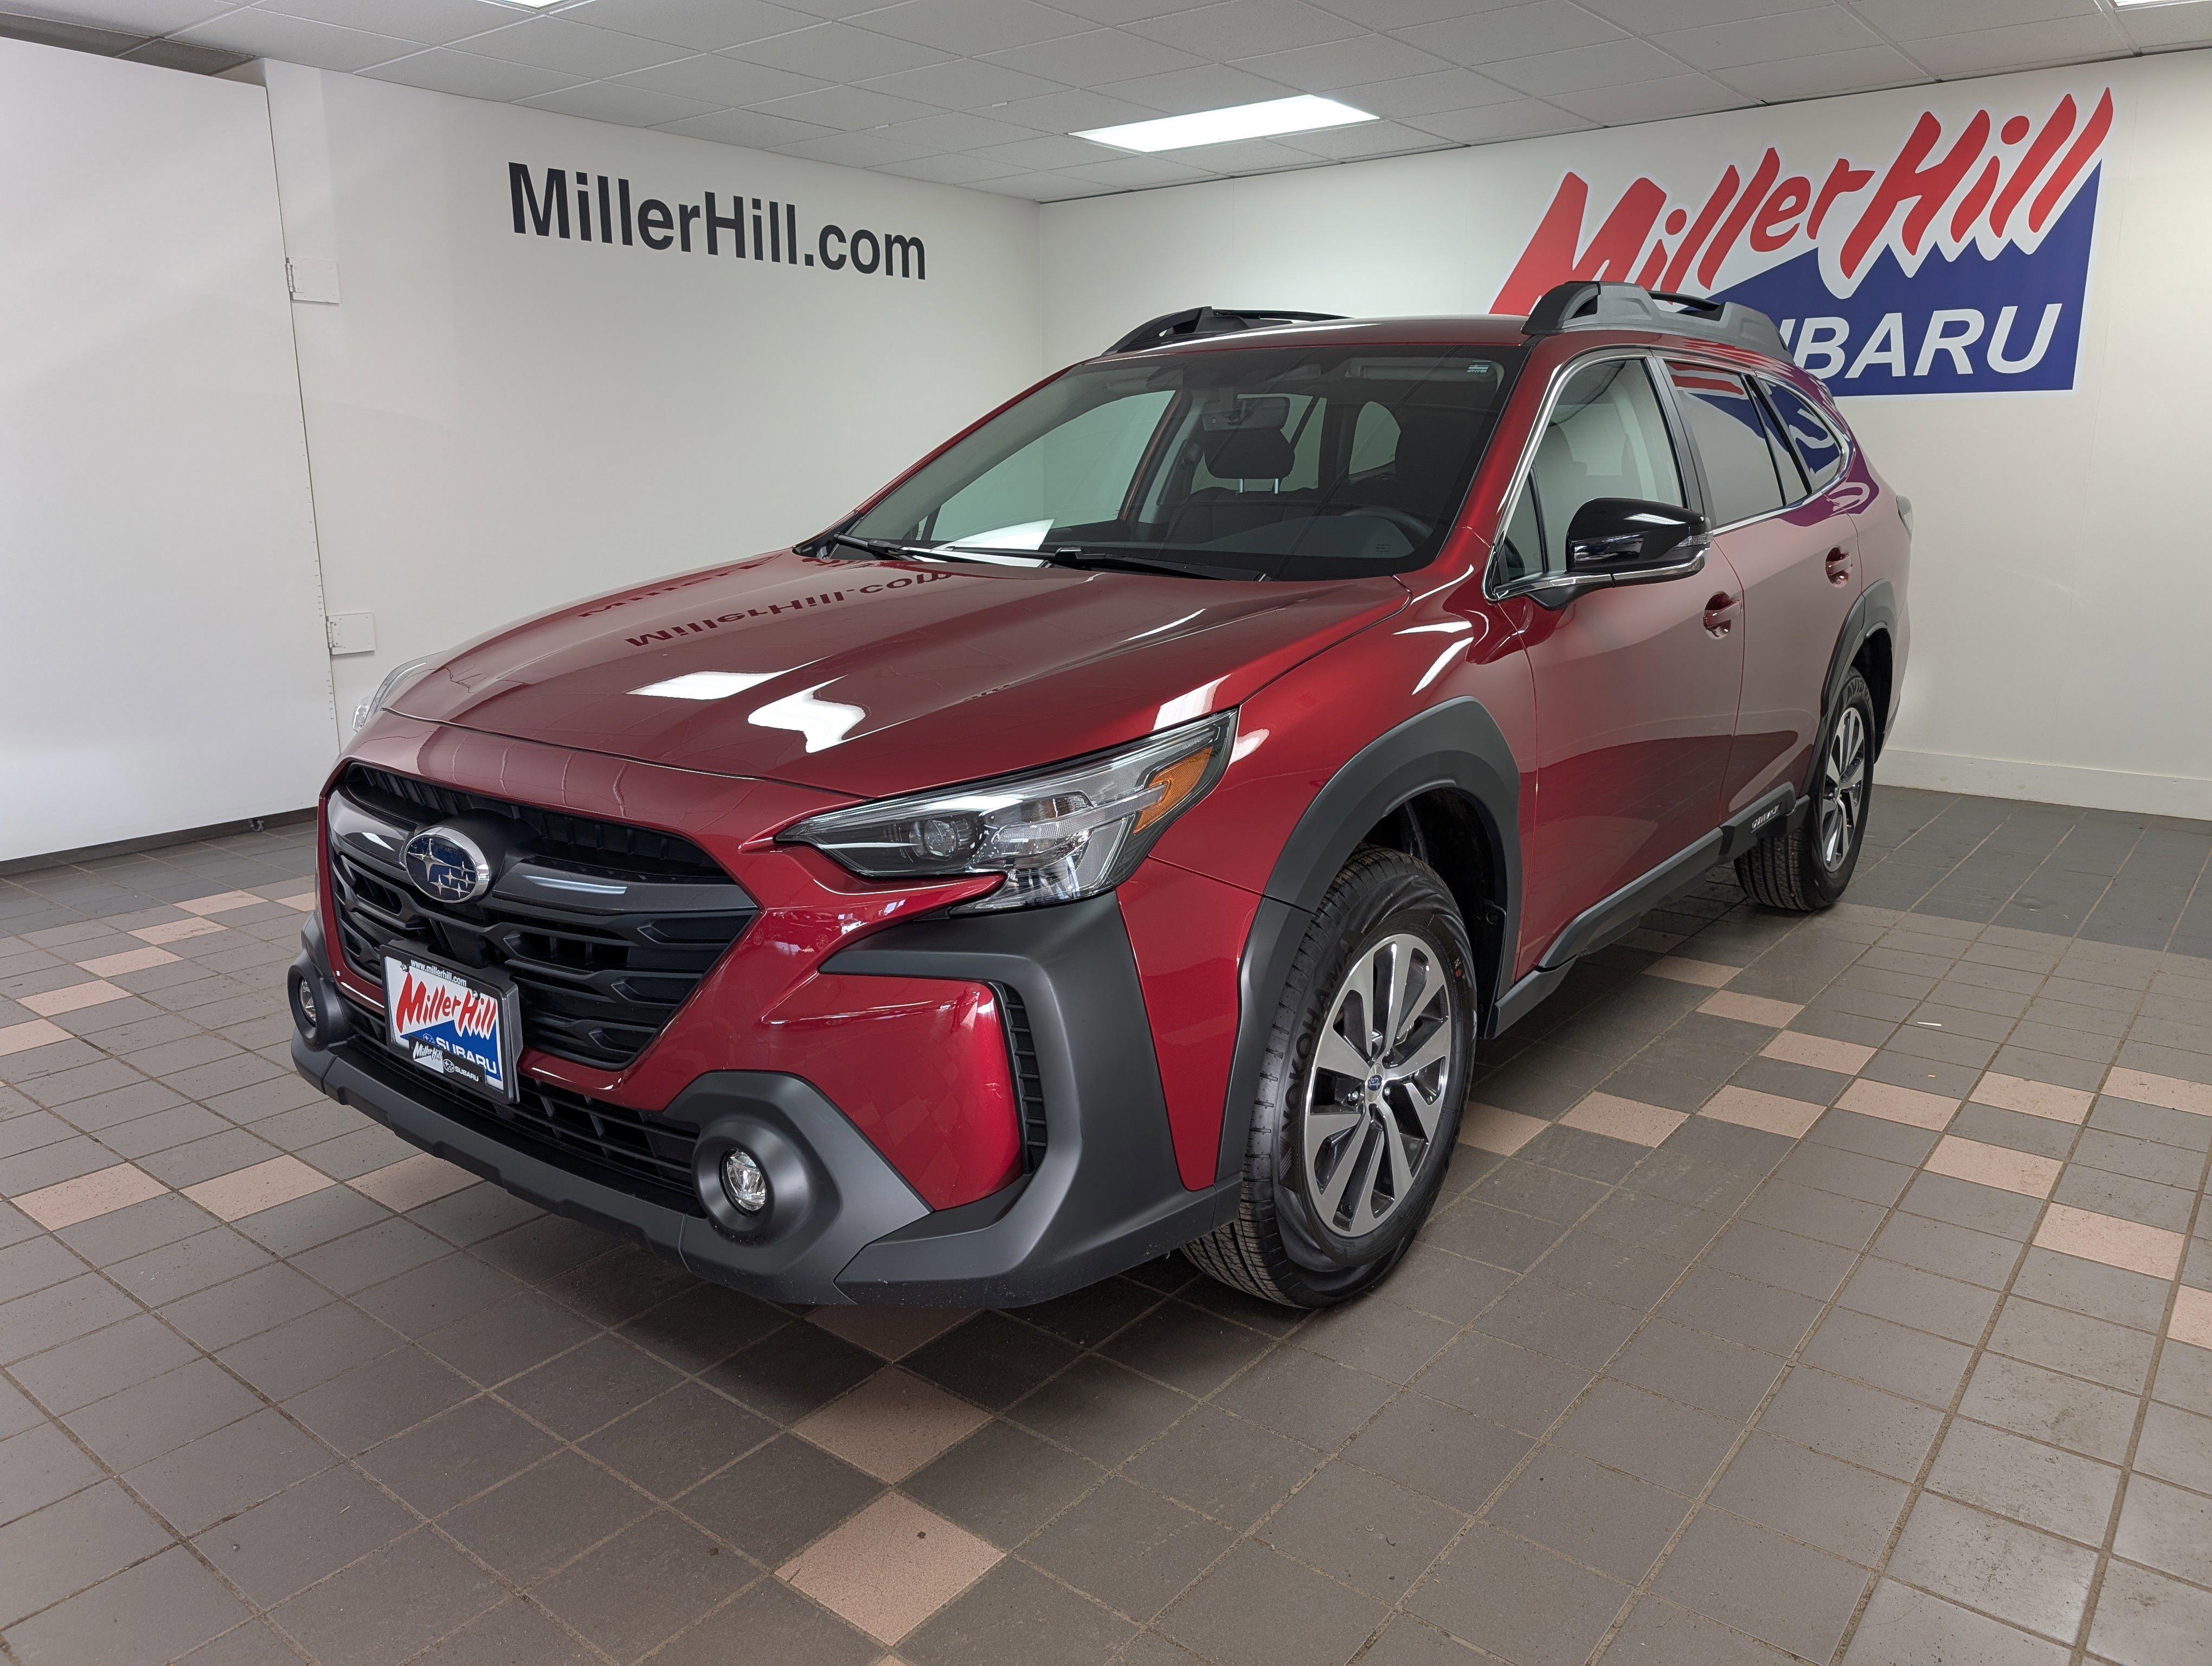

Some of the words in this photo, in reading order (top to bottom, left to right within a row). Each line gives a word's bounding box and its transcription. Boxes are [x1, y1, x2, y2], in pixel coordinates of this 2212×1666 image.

[509, 162, 925, 280] MillerHill.com
[1780, 303, 2062, 379] BARU
[410, 959, 467, 987] www.millerhill.com
[455, 1066, 479, 1082] SUBARU
